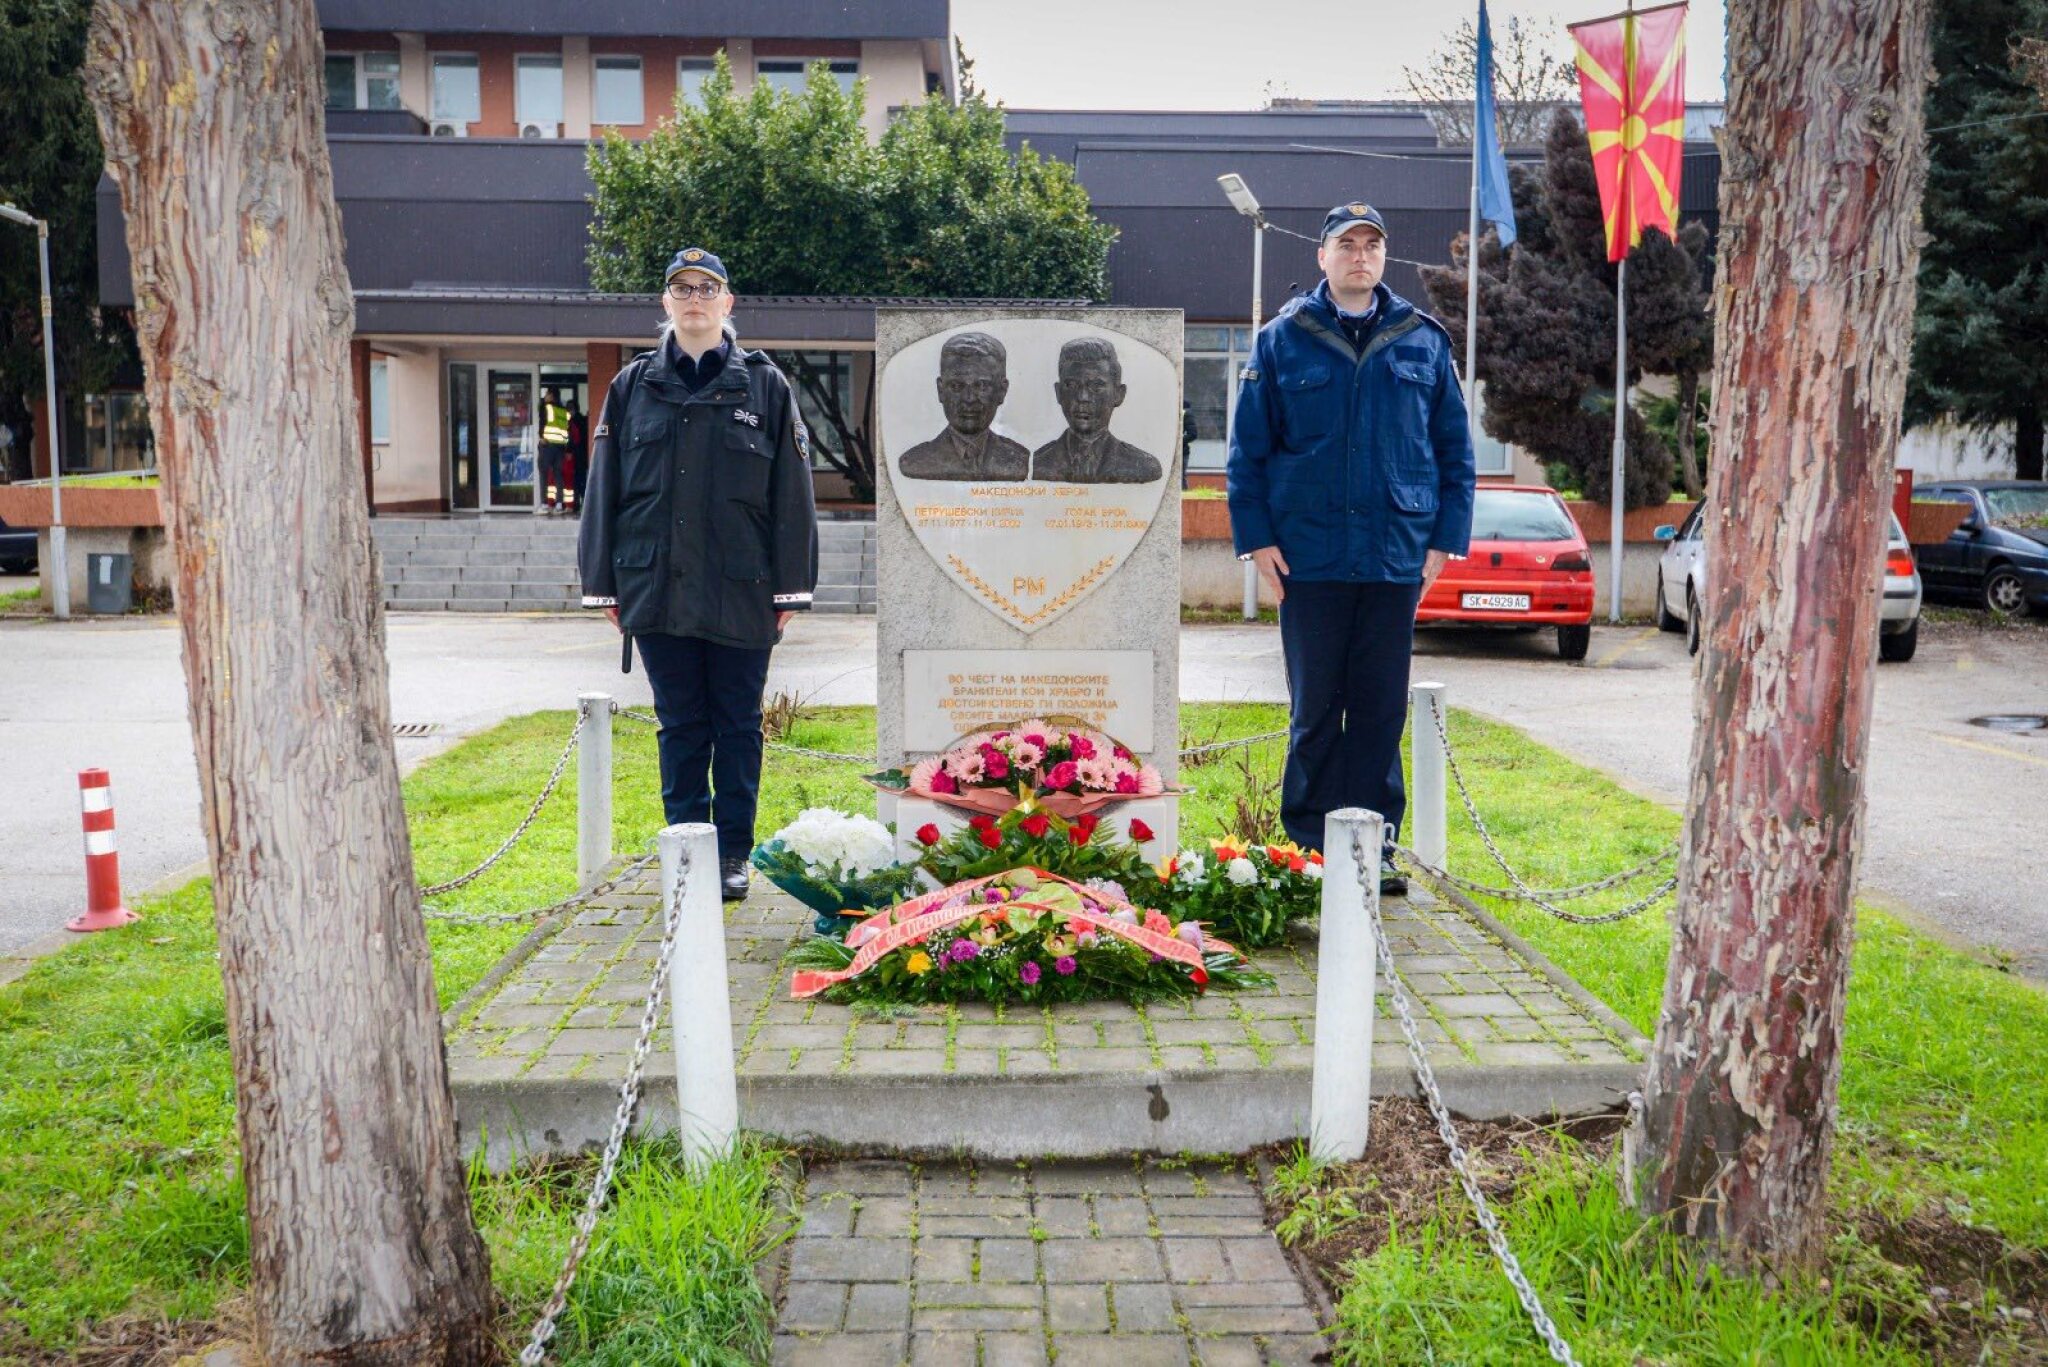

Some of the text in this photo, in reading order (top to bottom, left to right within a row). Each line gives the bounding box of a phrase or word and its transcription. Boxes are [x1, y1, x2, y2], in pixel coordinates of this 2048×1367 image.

[970, 487, 1046, 497] МАКЕДОНСКИ
[914, 507, 988, 517] ПЕТРУШЕВСКИ
[968, 675, 996, 685] ЧЕСТ
[1001, 675, 1016, 685] НА
[1020, 675, 1110, 685] МАКЕДОНСКИТЕ
[953, 687, 1017, 696] БРАНИТЕЛИ
[1021, 687, 1045, 696] КОИ
[1097, 687, 1105, 697] И
